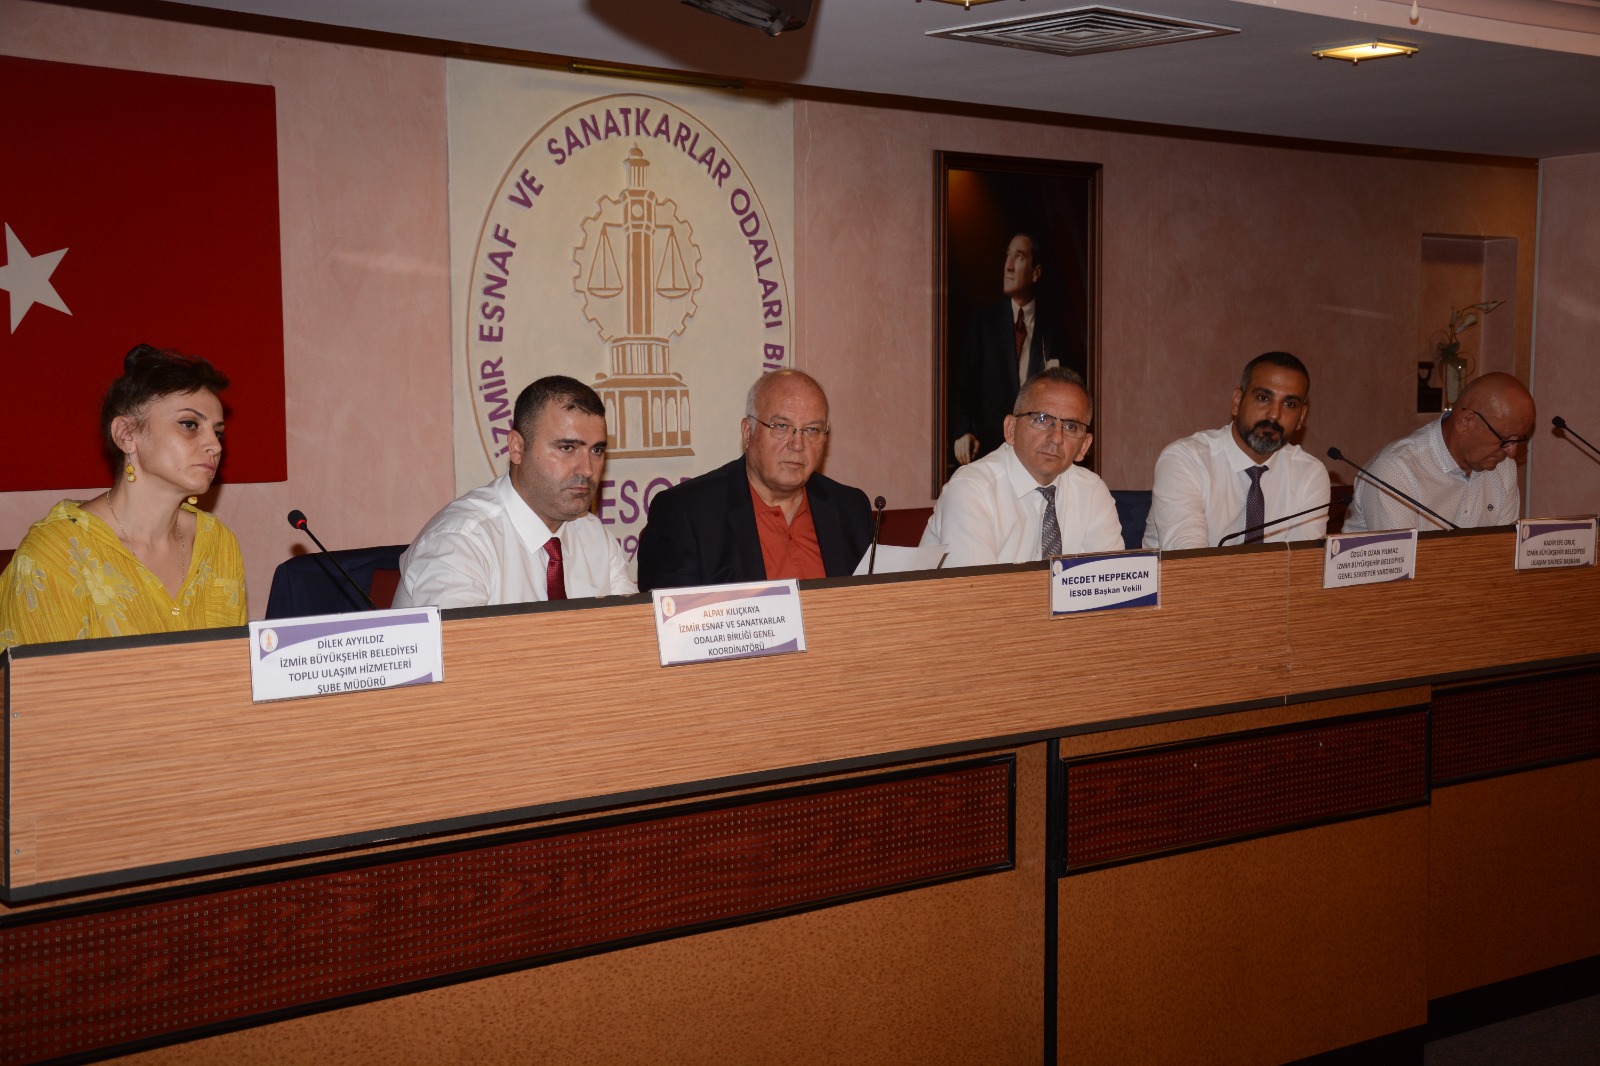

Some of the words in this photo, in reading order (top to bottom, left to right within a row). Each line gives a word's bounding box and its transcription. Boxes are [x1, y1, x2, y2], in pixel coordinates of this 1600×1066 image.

[479, 223, 517, 342] ESNAF
[508, 168, 544, 209] VE
[547, 107, 732, 188] SANATKARLAR
[730, 188, 783, 329] ODALARI
[1381, 547, 1399, 555] YILMAZ
[1336, 561, 1351, 570] İZMİR
[1351, 559, 1380, 568] BÜYÜKŞEHİR
[1380, 556, 1405, 566] BELEDİYESİ
[1062, 575, 1096, 585] NECDET
[1098, 570, 1149, 582] HEPPEKCAN
[1337, 572, 1353, 580] GENEL
[1353, 569, 1376, 578] SEKRETER
[1094, 587, 1120, 596] Başkan
[703, 608, 724, 618] ALPAY
[726, 605, 760, 617] KILIÇKAYA
[679, 622, 701, 633] İZMİR
[702, 620, 725, 631] ESNAF
[725, 619, 735, 629] VE
[736, 616, 786, 627] SANATKARLAR
[317, 638, 344, 649] DİLEK
[345, 635, 384, 646] AYYILDIZ
[693, 634, 726, 645] ODALARI
[727, 630, 752, 641] BİRLİĞİ
[753, 629, 776, 638] GENEL
[280, 656, 307, 668] İZMİR
[310, 649, 368, 664] BÜYÜKŞEHİR
[370, 643, 418, 658] BELEDİYESİ
[708, 642, 765, 656] KOORDİNATÖRÜ
[289, 670, 319, 682] TOPLU
[321, 666, 357, 679] ULAŞIM
[359, 658, 412, 673] HİZMETLERİ
[317, 681, 341, 694] ŞUBE
[344, 677, 386, 691] MÜDÜRÜ
